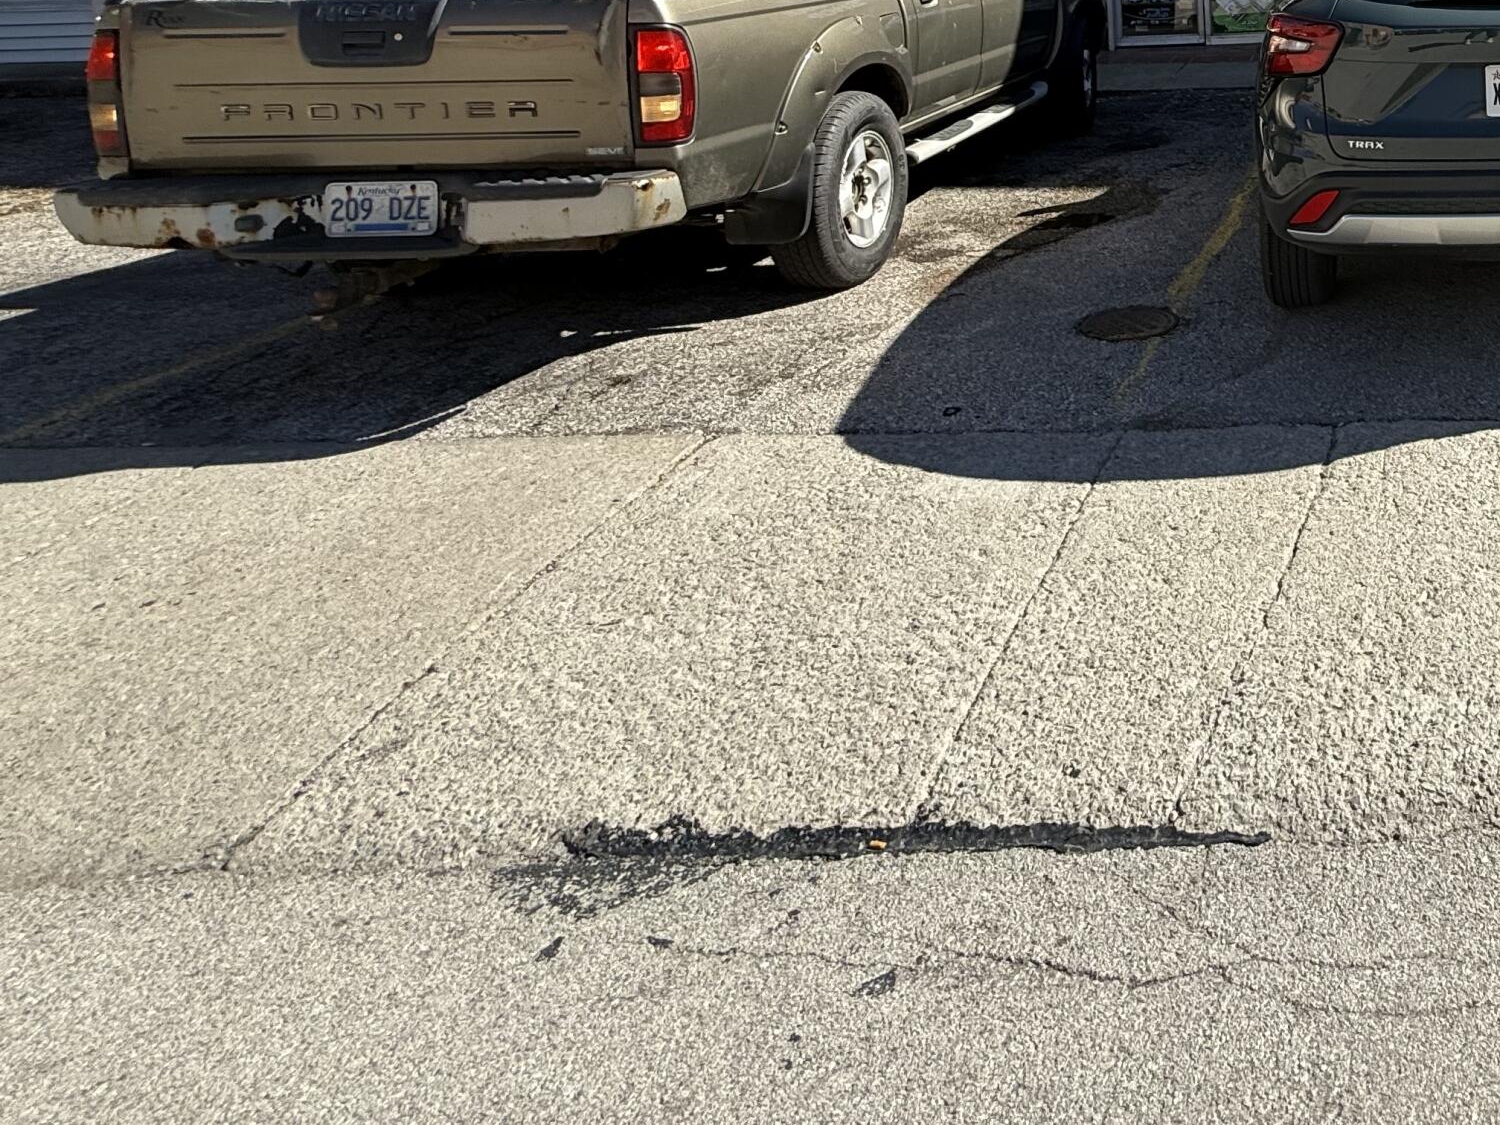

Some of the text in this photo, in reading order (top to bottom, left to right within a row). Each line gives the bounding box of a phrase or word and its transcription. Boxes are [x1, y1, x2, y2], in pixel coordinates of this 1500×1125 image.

[316, 2, 417, 22] NISSAN
[221, 101, 539, 122] FRONTIER
[1347, 140, 1385, 149] TRAX
[357, 186, 401, 196] Kentucky
[331, 195, 431, 222] 209 DZE
